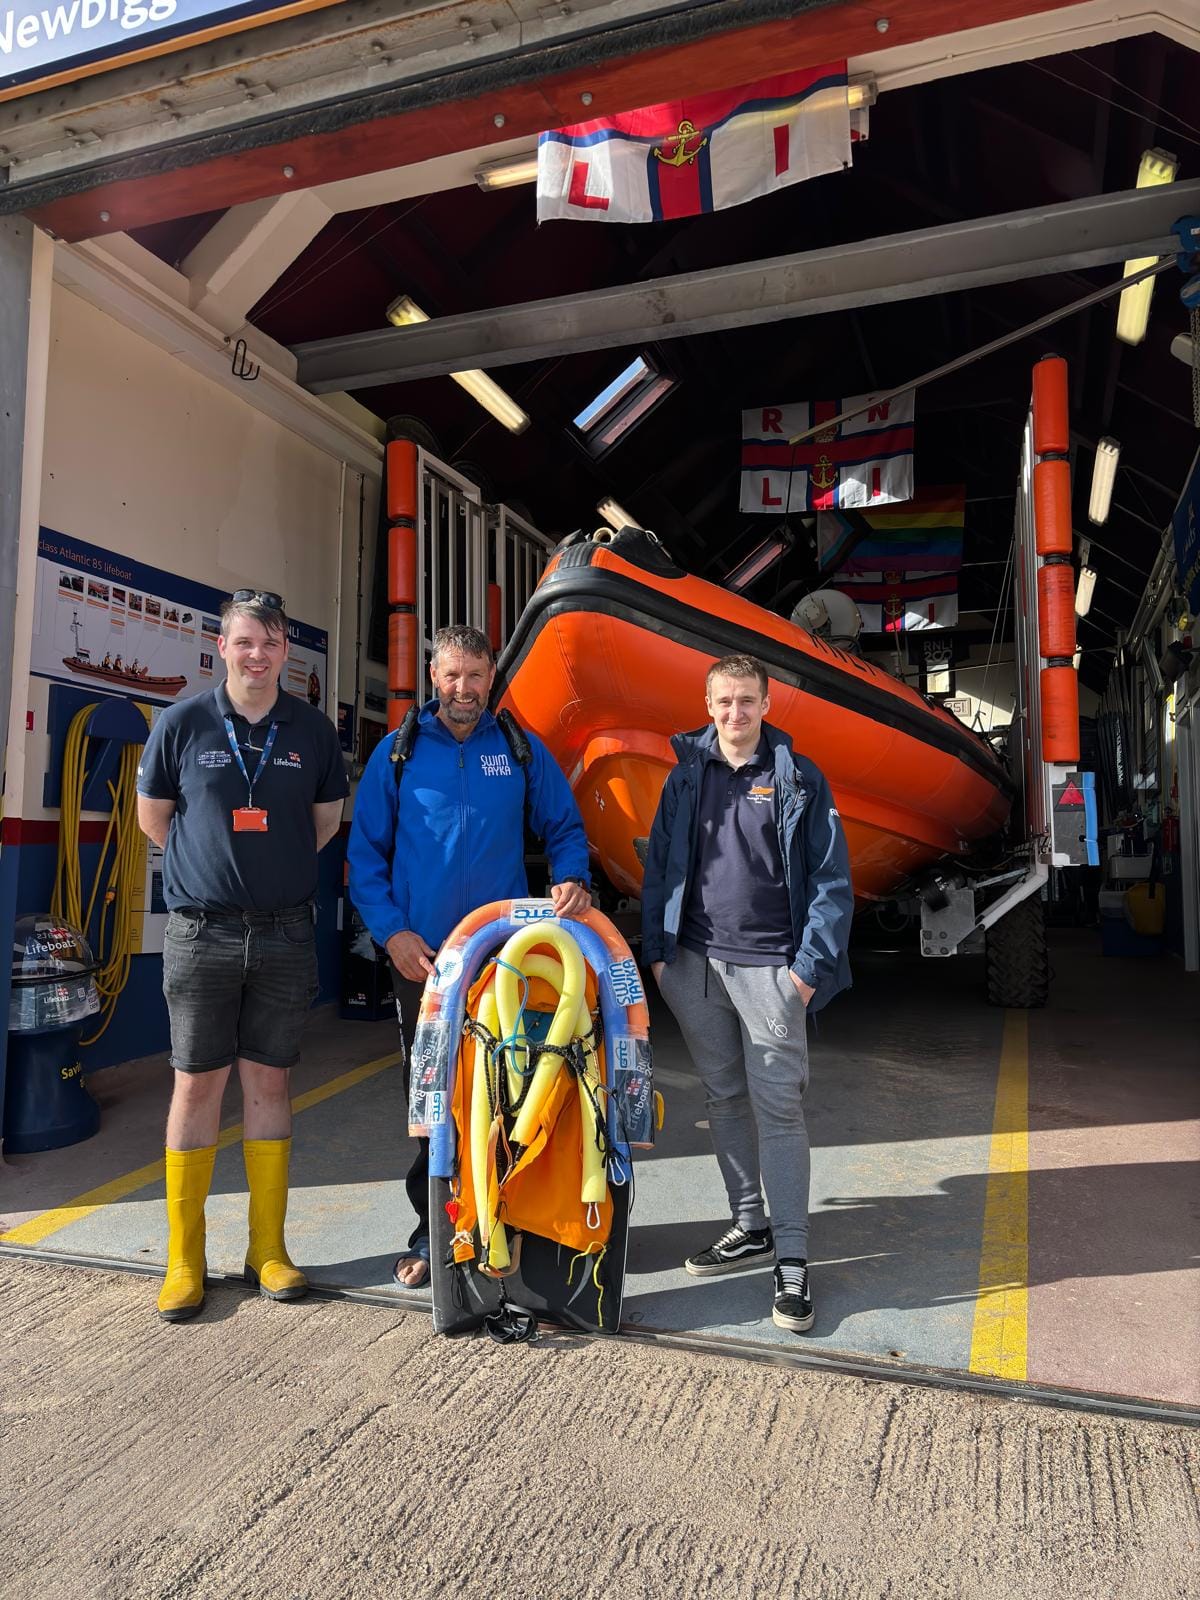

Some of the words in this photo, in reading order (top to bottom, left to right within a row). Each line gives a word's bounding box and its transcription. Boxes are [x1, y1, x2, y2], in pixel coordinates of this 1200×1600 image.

[567, 160, 610, 211] L
[762, 407, 784, 433] R
[762, 477, 782, 506] L
[38, 539, 58, 554] class
[59, 546, 92, 567] Atlantic
[92, 558, 102, 570] 85
[104, 562, 132, 580] lifeboat
[923, 637, 953, 652] RNLI
[273, 757, 302, 769] Lifeboats
[480, 753, 509, 767] SWIM
[481, 766, 511, 776] TAYKA
[25, 938, 77, 955] Lifeboats
[608, 962, 632, 1005] SWIM
[622, 958, 643, 1004] TAYKA
[620, 1040, 628, 1069] GTC
[432, 1092, 441, 1122] GTC
[631, 1080, 651, 1131] Lifeboats
